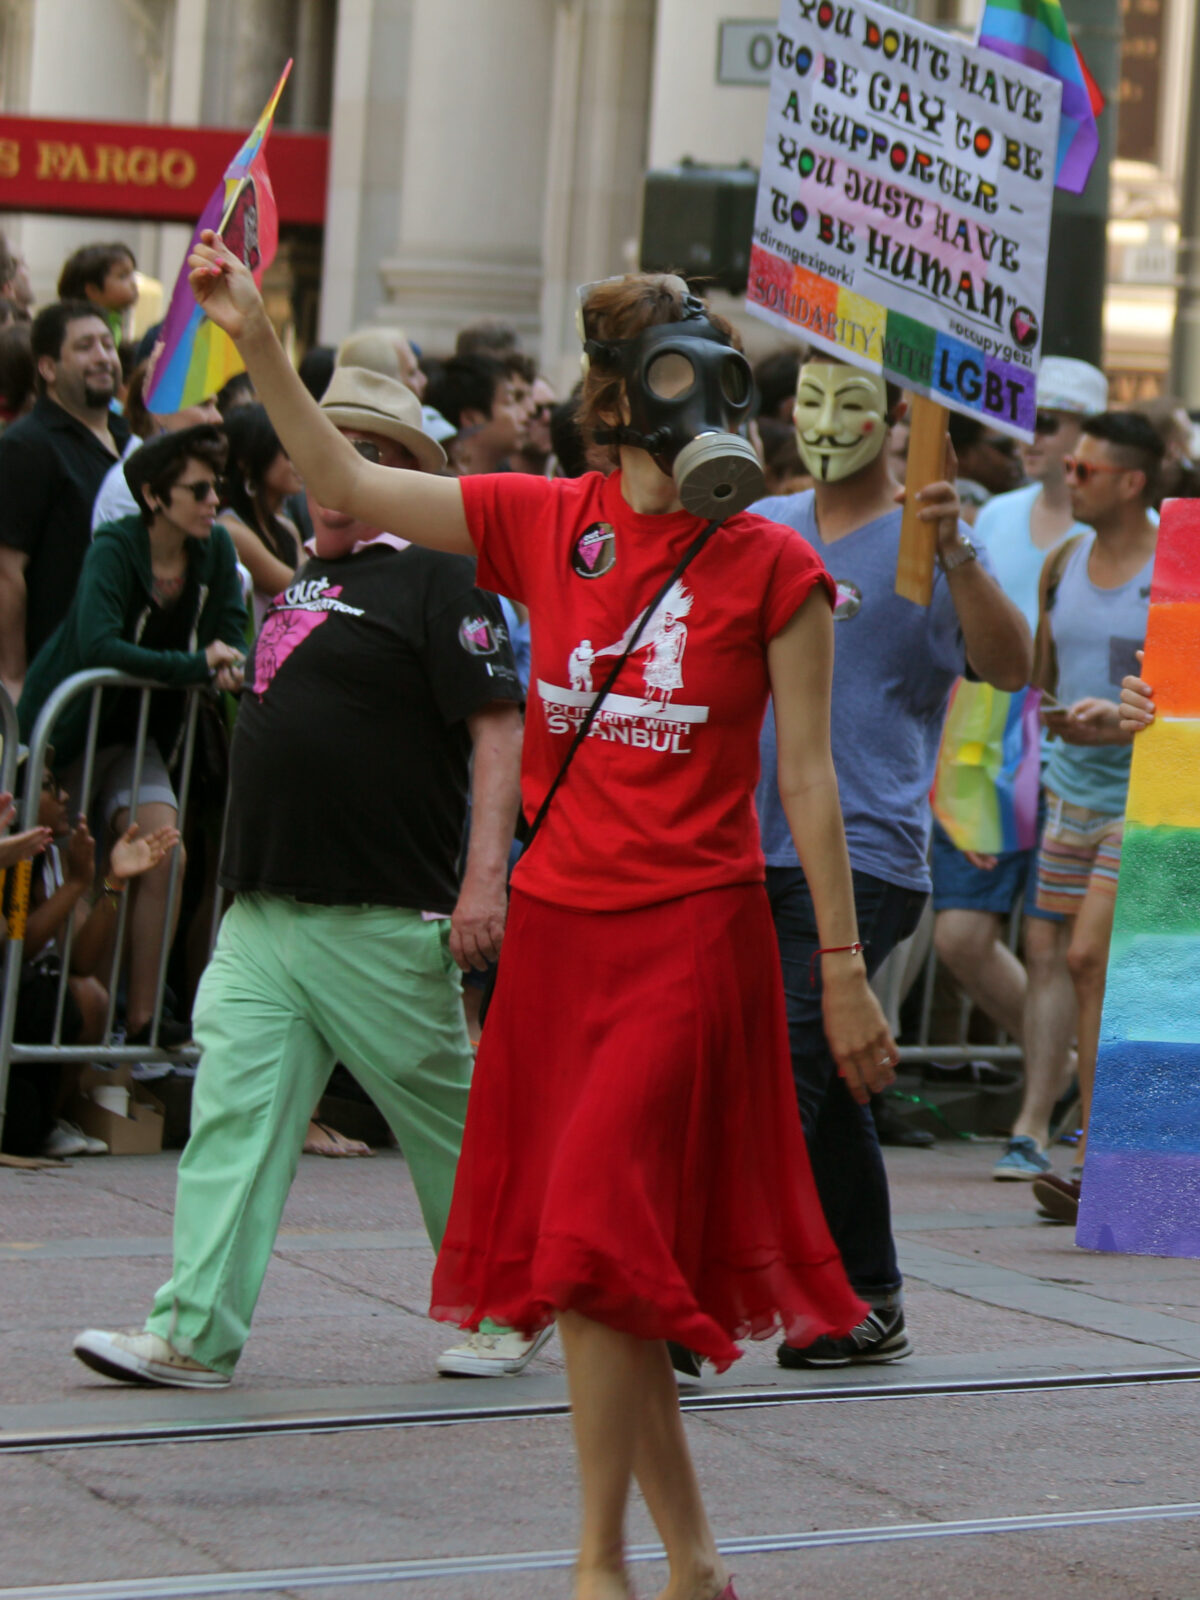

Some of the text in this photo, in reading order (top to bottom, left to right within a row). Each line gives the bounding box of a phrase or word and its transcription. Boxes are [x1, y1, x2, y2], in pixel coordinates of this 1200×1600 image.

[777, 32, 1043, 181] TO BE GAY TO BE
[960, 54, 1043, 123] HAVE
[36, 139, 196, 190] FARGO
[782, 90, 801, 124] A
[811, 102, 998, 214] SUPPORTER
[771, 186, 808, 232] TO
[817, 209, 855, 254] BE
[778, 133, 1020, 273] YOU JUST HAVE
[754, 276, 877, 354] SOLIDARITY
[881, 335, 933, 381] WITH
[938, 349, 1025, 421] LGBT
[643, 717, 690, 735] WITH
